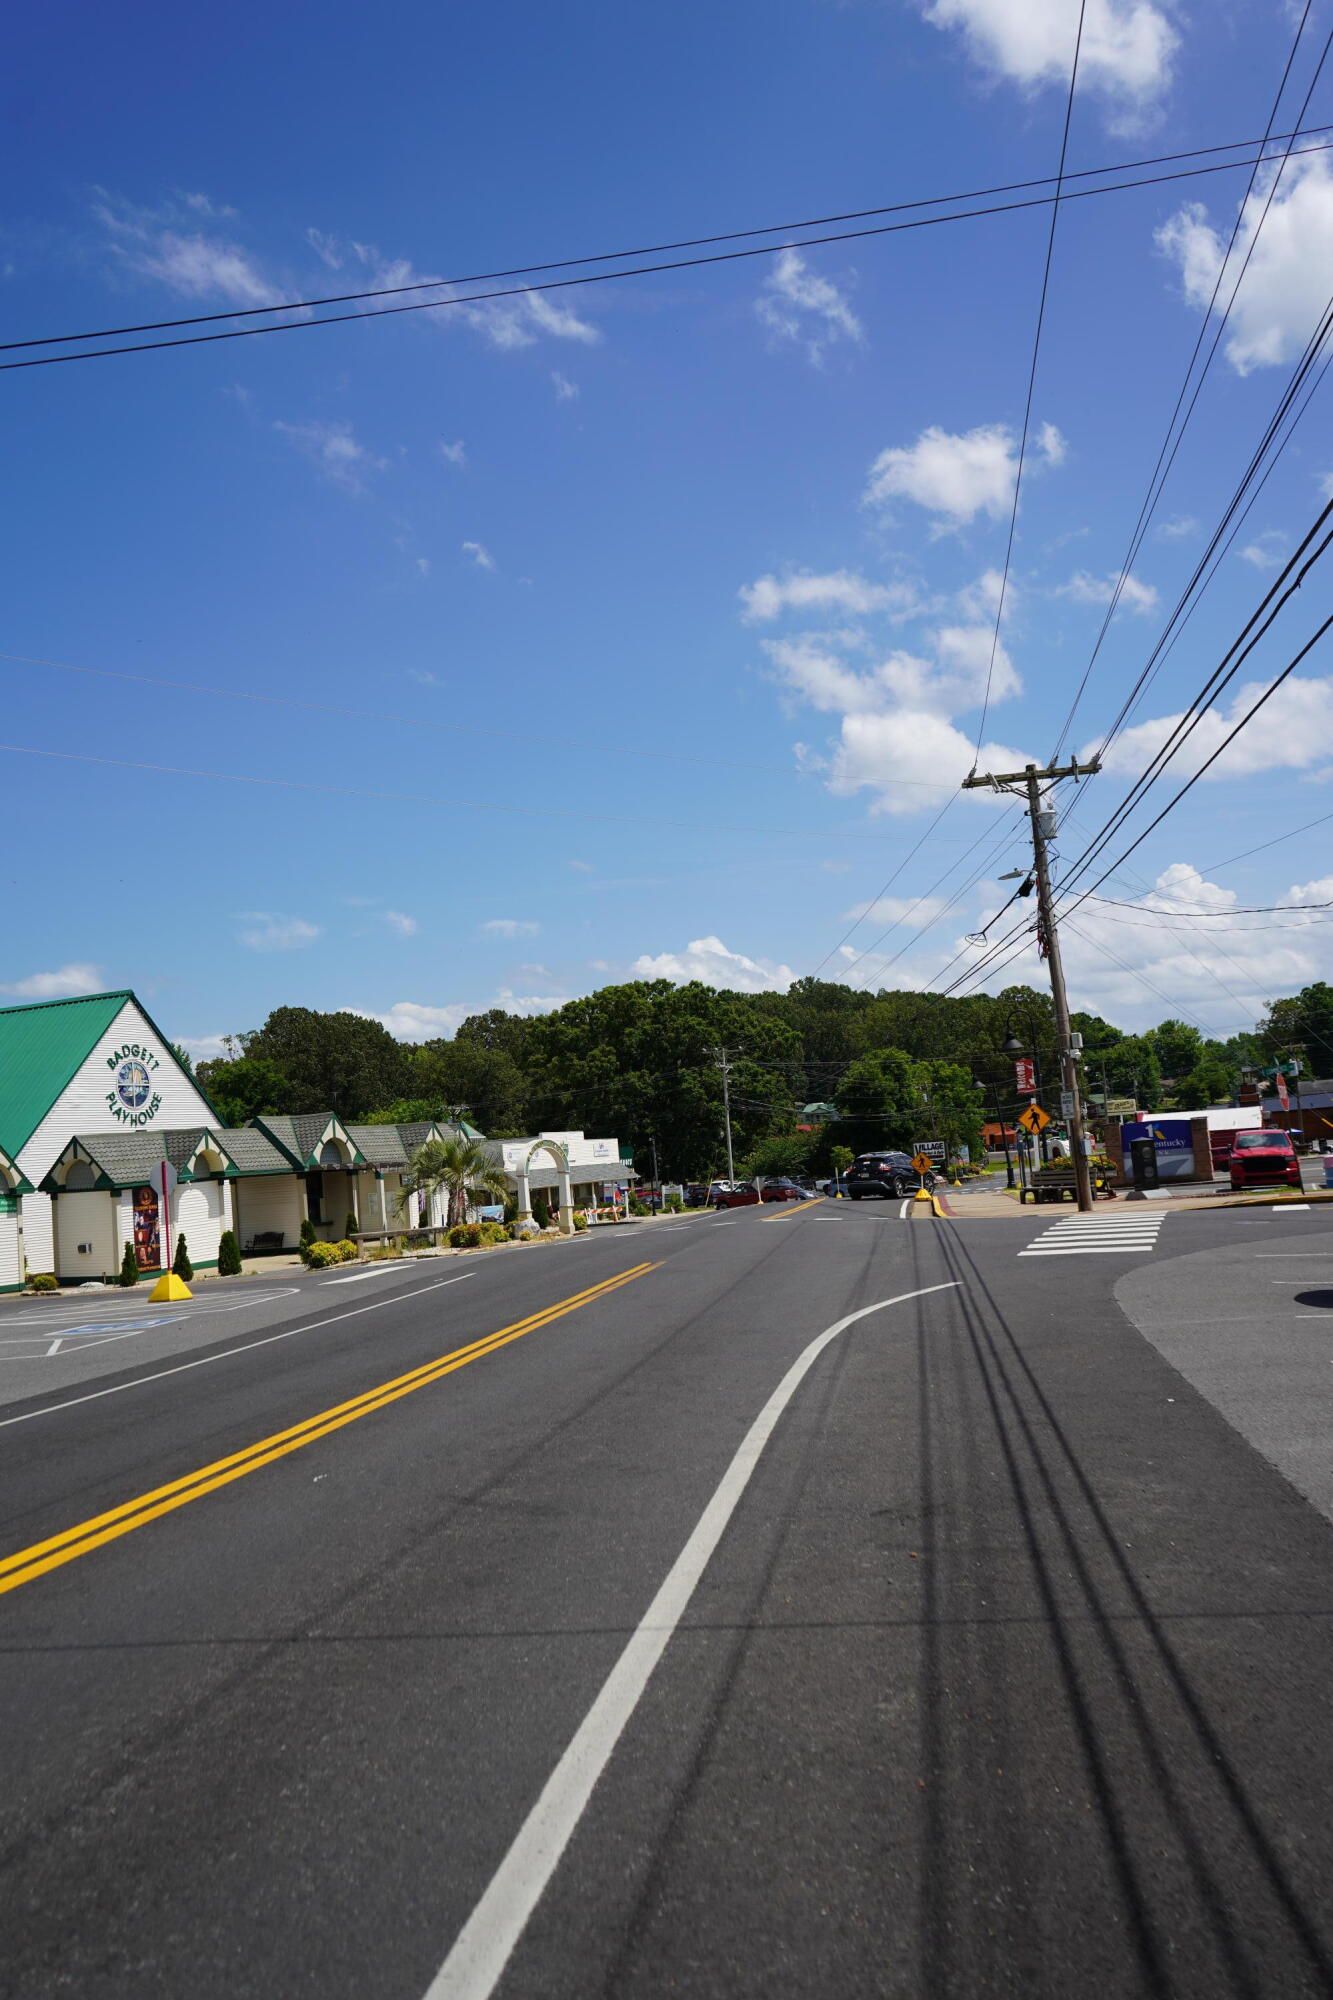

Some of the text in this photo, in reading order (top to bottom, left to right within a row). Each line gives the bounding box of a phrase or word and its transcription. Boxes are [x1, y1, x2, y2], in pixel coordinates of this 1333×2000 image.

[106, 1044, 160, 1070] BADGETT
[105, 1091, 162, 1127] PLAYHOUSE
[914, 1143, 944, 1155] VILLAGE
[1153, 1139, 1186, 1148] entucky
